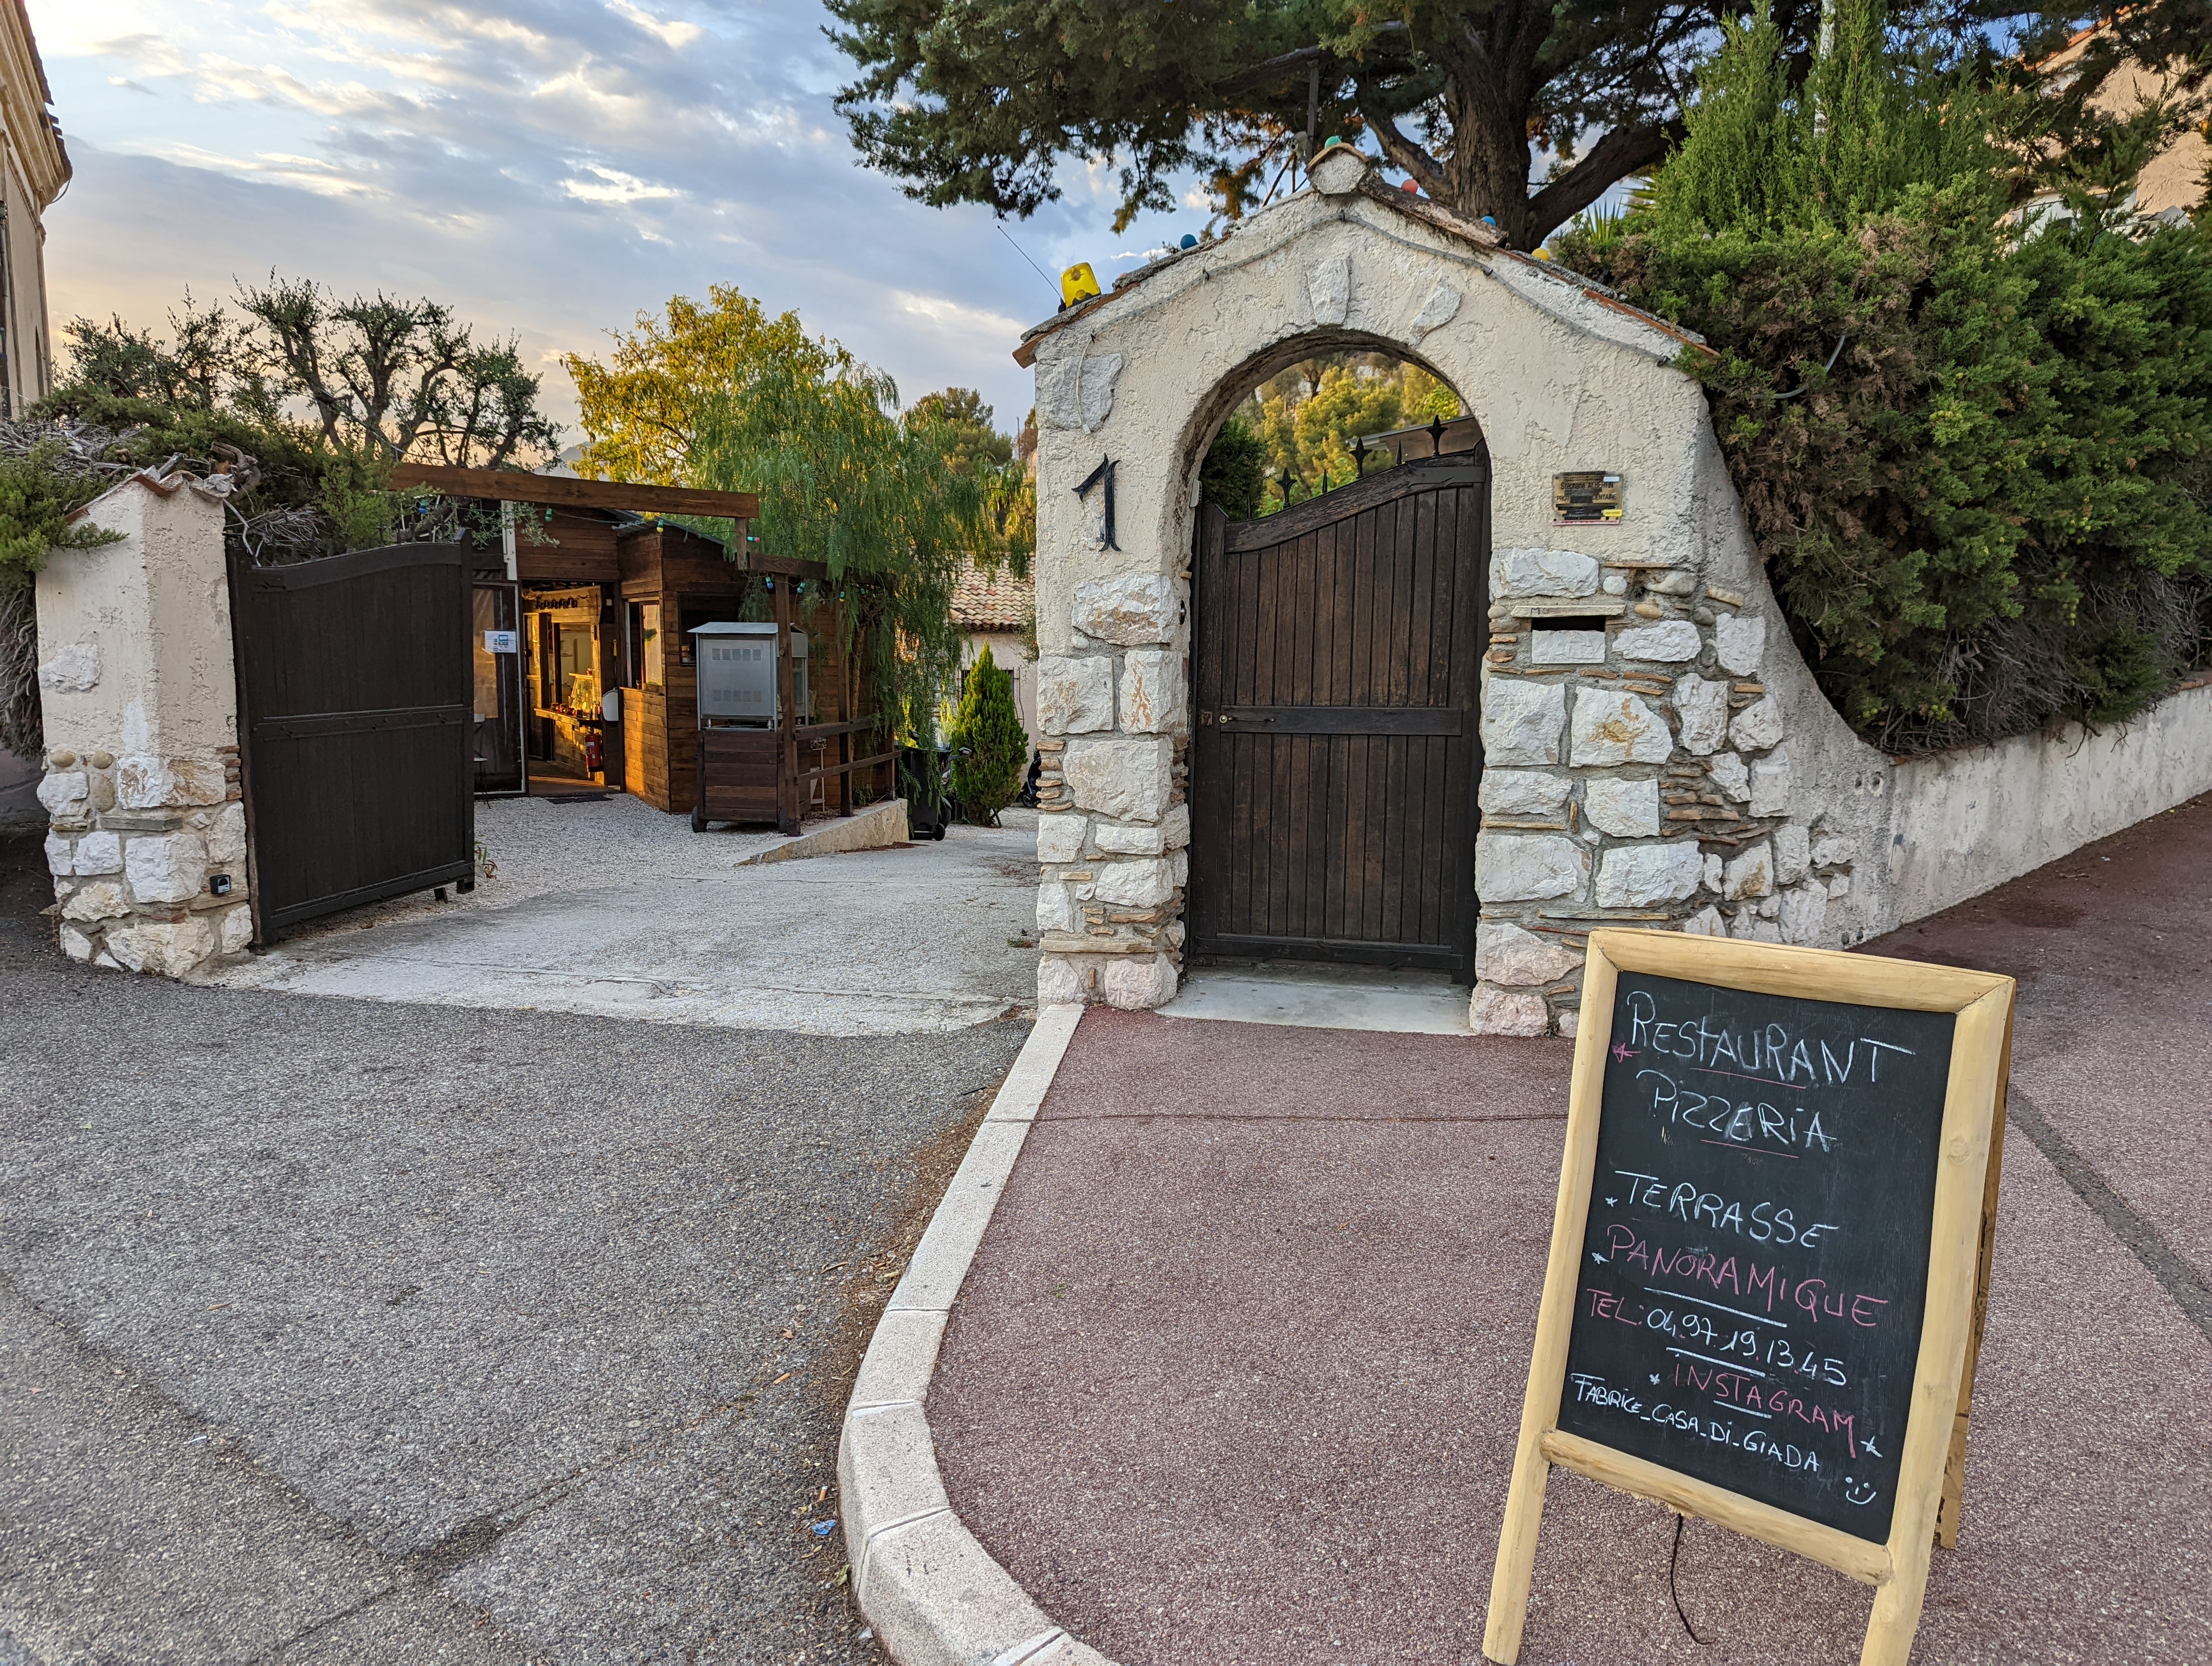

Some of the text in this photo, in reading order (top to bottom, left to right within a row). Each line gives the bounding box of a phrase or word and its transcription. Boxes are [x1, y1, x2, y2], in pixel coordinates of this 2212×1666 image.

[1071, 452, 1122, 552] 1
[1615, 1170, 1839, 1247] TERRASSE
[1606, 1223, 1889, 1327] PANORAMIQUE
